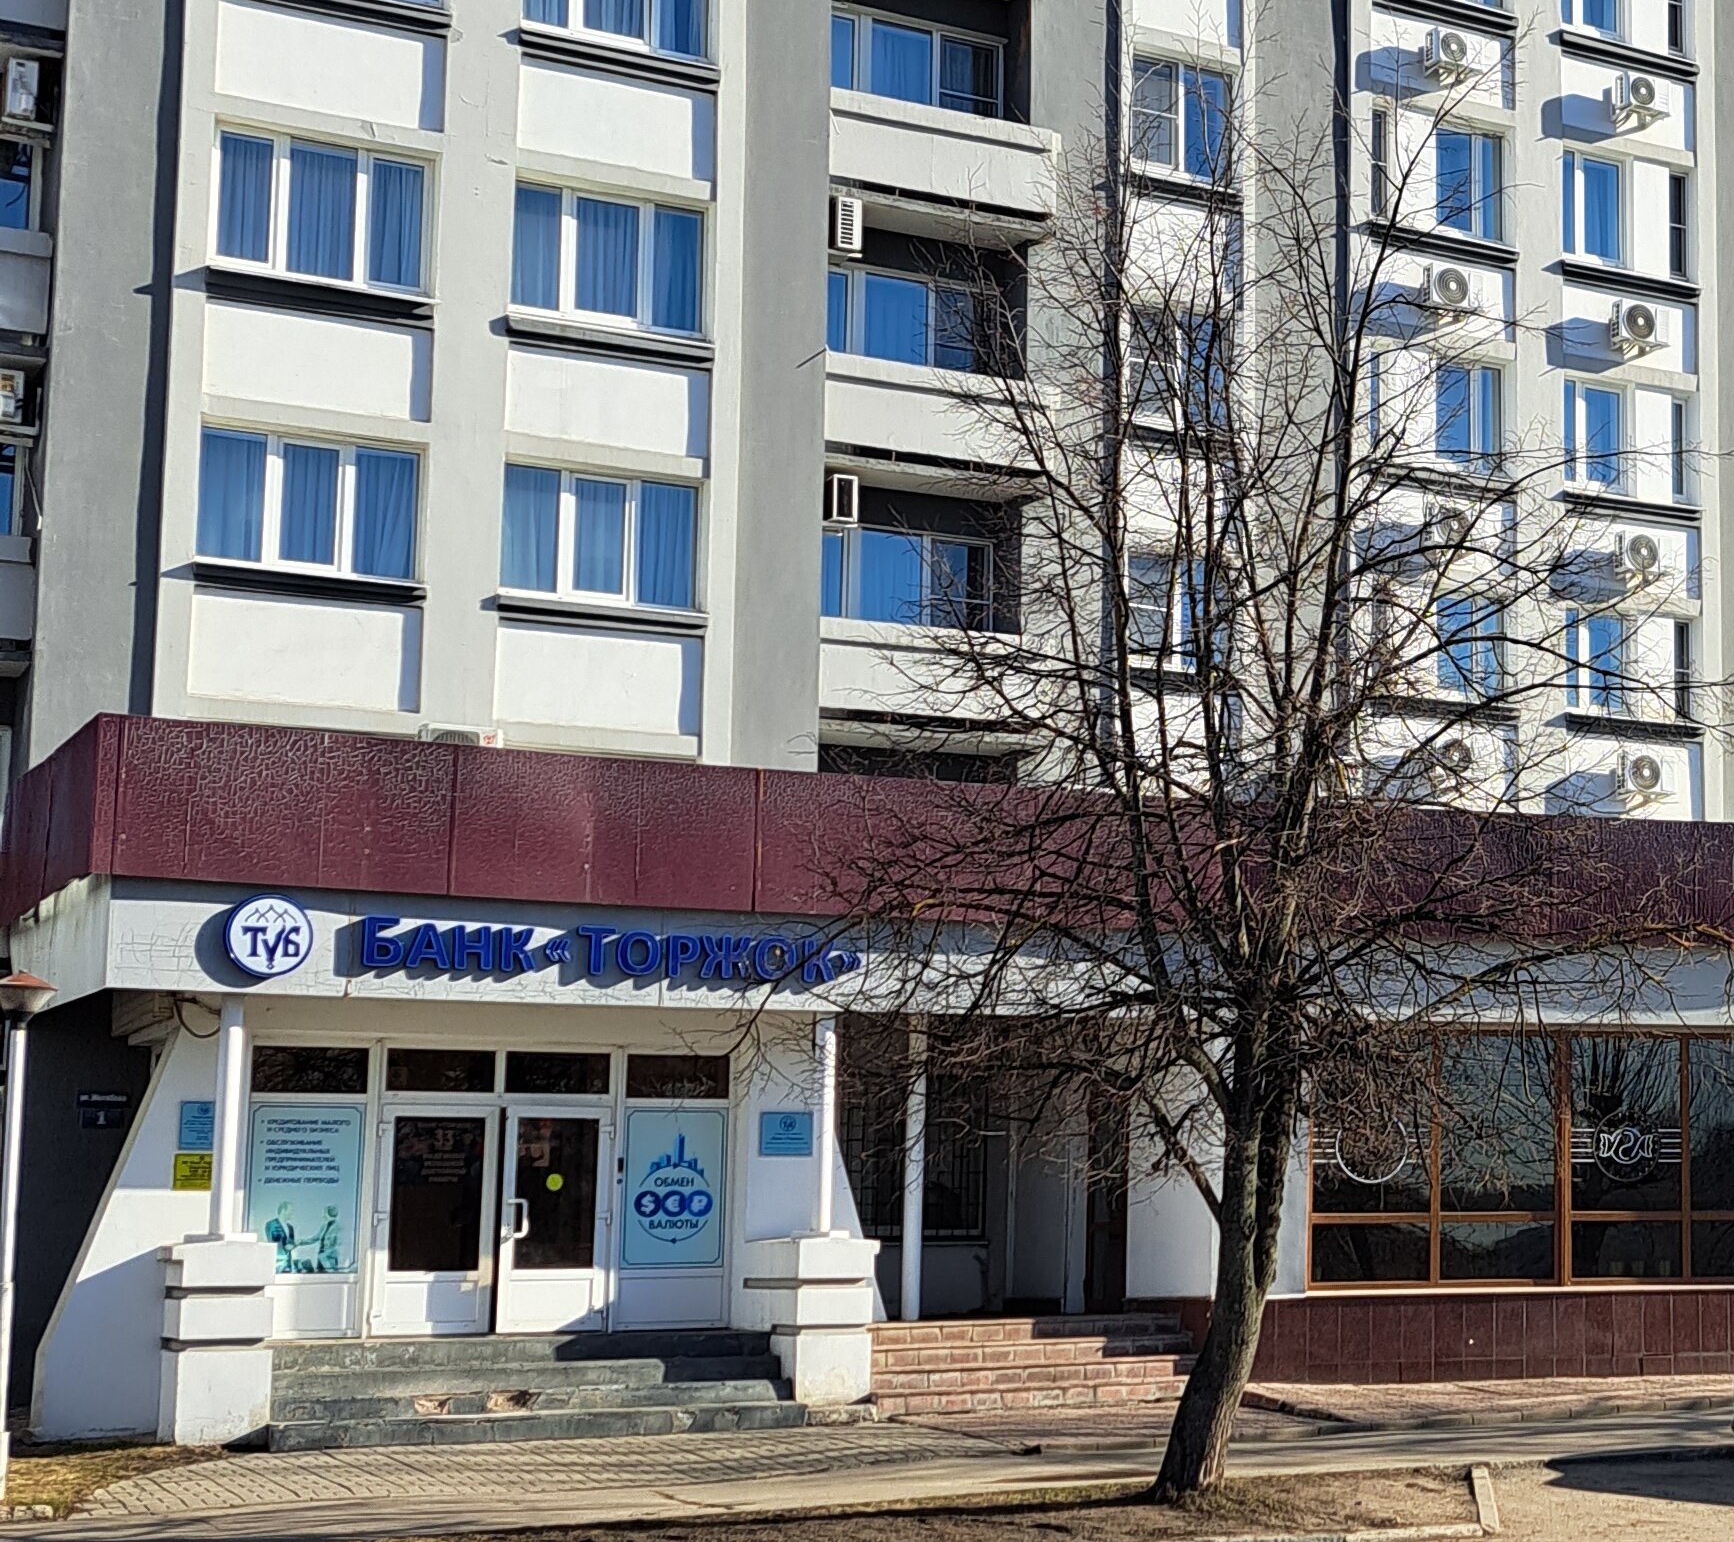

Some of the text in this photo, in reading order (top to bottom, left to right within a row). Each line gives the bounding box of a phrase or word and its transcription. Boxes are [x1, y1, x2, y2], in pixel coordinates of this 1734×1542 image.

[361, 916, 535, 972] БАНК
[96, 1111, 107, 1125] 1
[654, 1177, 694, 1187] ОБМЕН
[648, 1219, 699, 1229] ВАЛЮТЫ
